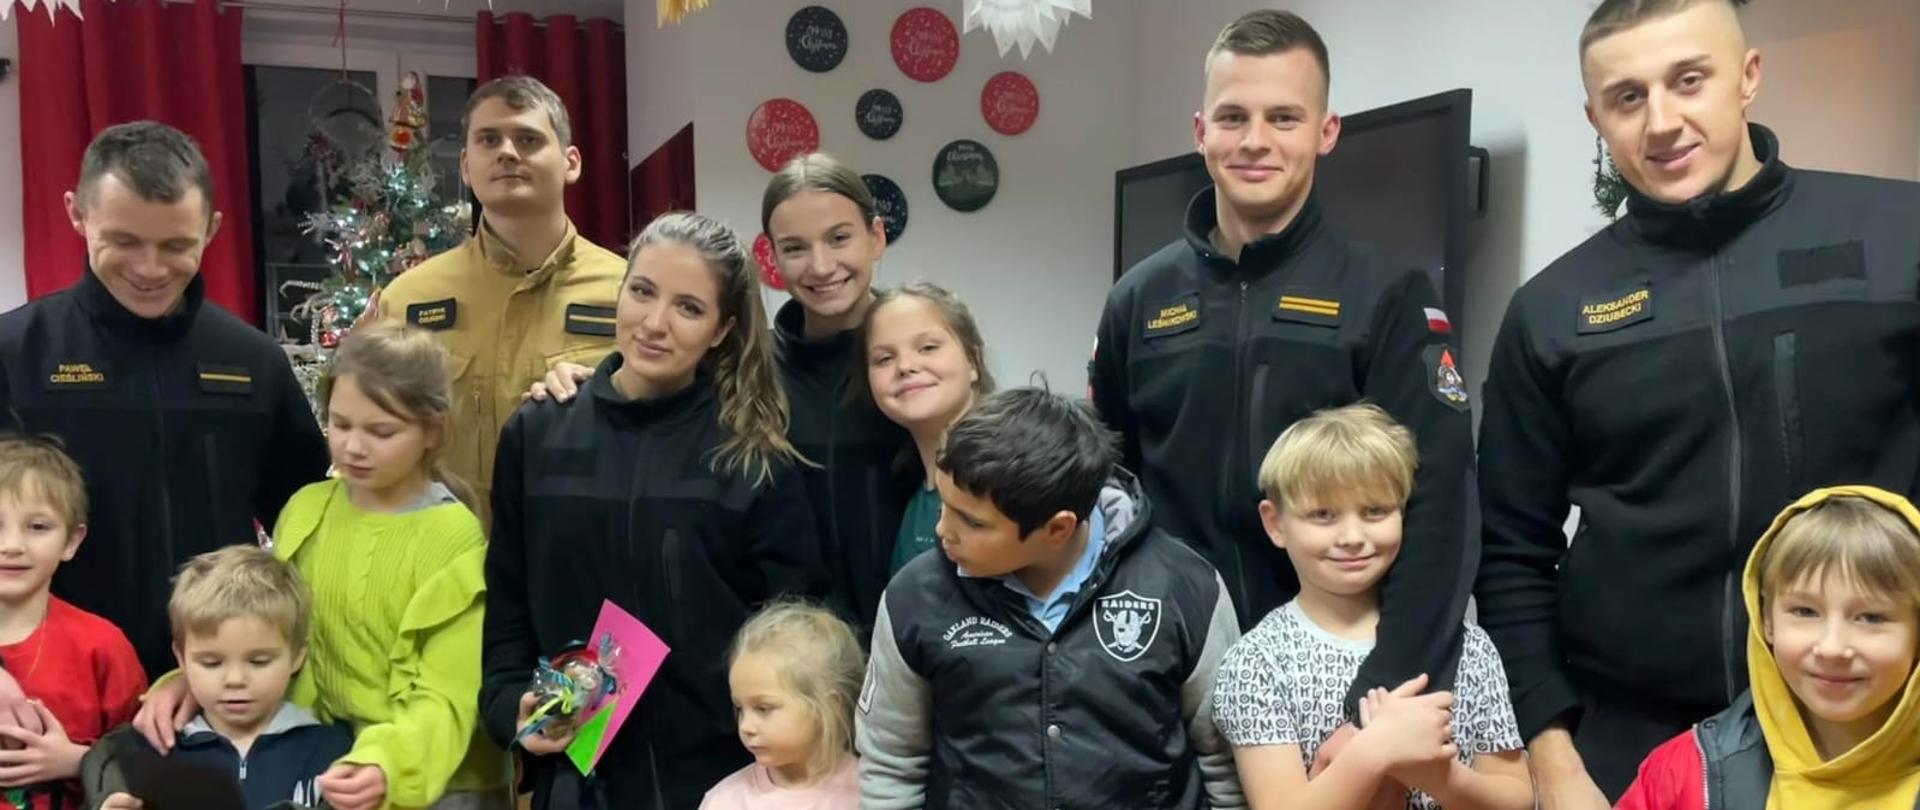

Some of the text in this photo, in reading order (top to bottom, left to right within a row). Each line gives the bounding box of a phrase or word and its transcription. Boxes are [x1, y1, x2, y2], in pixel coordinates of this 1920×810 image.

[1582, 290, 1649, 314] ALEKSANDER
[1588, 303, 1642, 324] DZIUBECKI
[1101, 599, 1155, 611] RAIDERS
